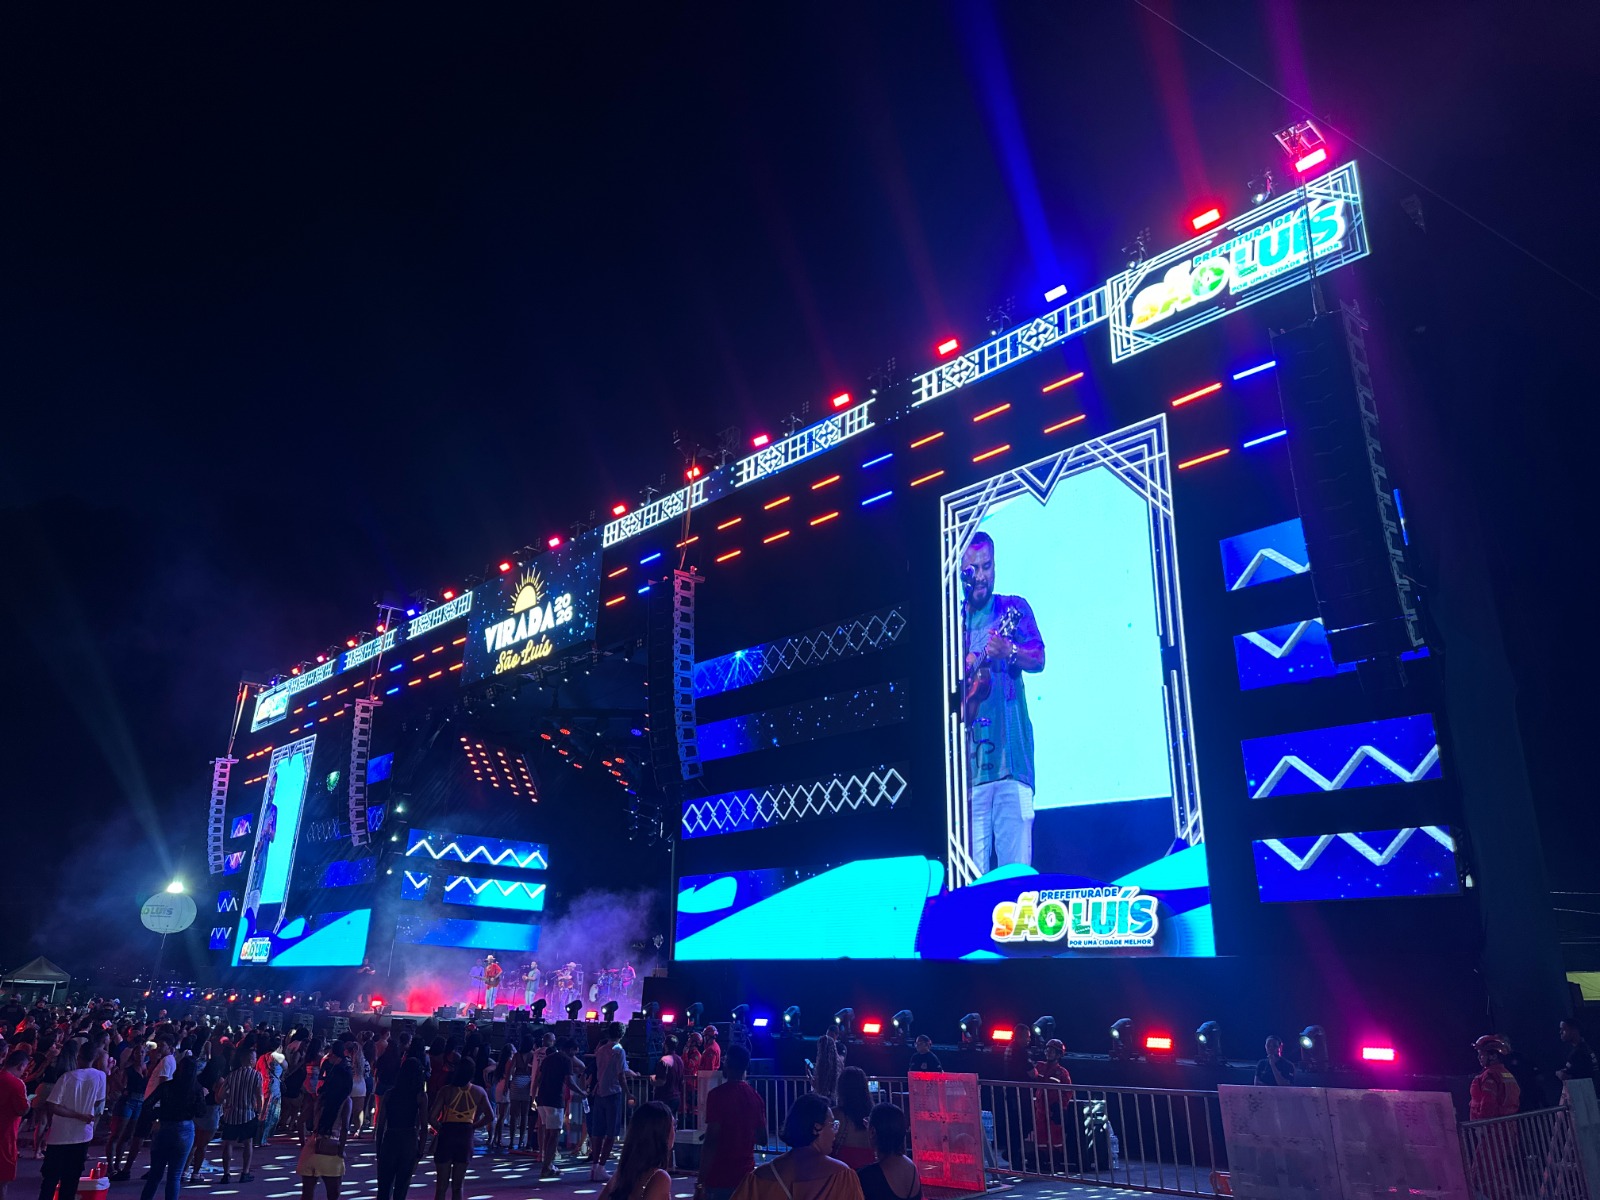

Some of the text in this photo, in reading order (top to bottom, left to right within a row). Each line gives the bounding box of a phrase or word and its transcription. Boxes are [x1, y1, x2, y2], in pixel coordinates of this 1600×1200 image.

[1194, 212, 1292, 265] PREFEITURA DE
[1231, 242, 1340, 293] POR UMA CIDADE MLHOR
[553, 592, 572, 612] 20
[484, 601, 555, 654] VIRADA
[494, 634, 553, 675] São Luís
[994, 888, 1154, 936] SÃO LUÍS
[1041, 887, 1118, 901] PREFEITURA DE
[1098, 938, 1123, 946] CIDADE
[1123, 938, 1152, 946] MELHOR
